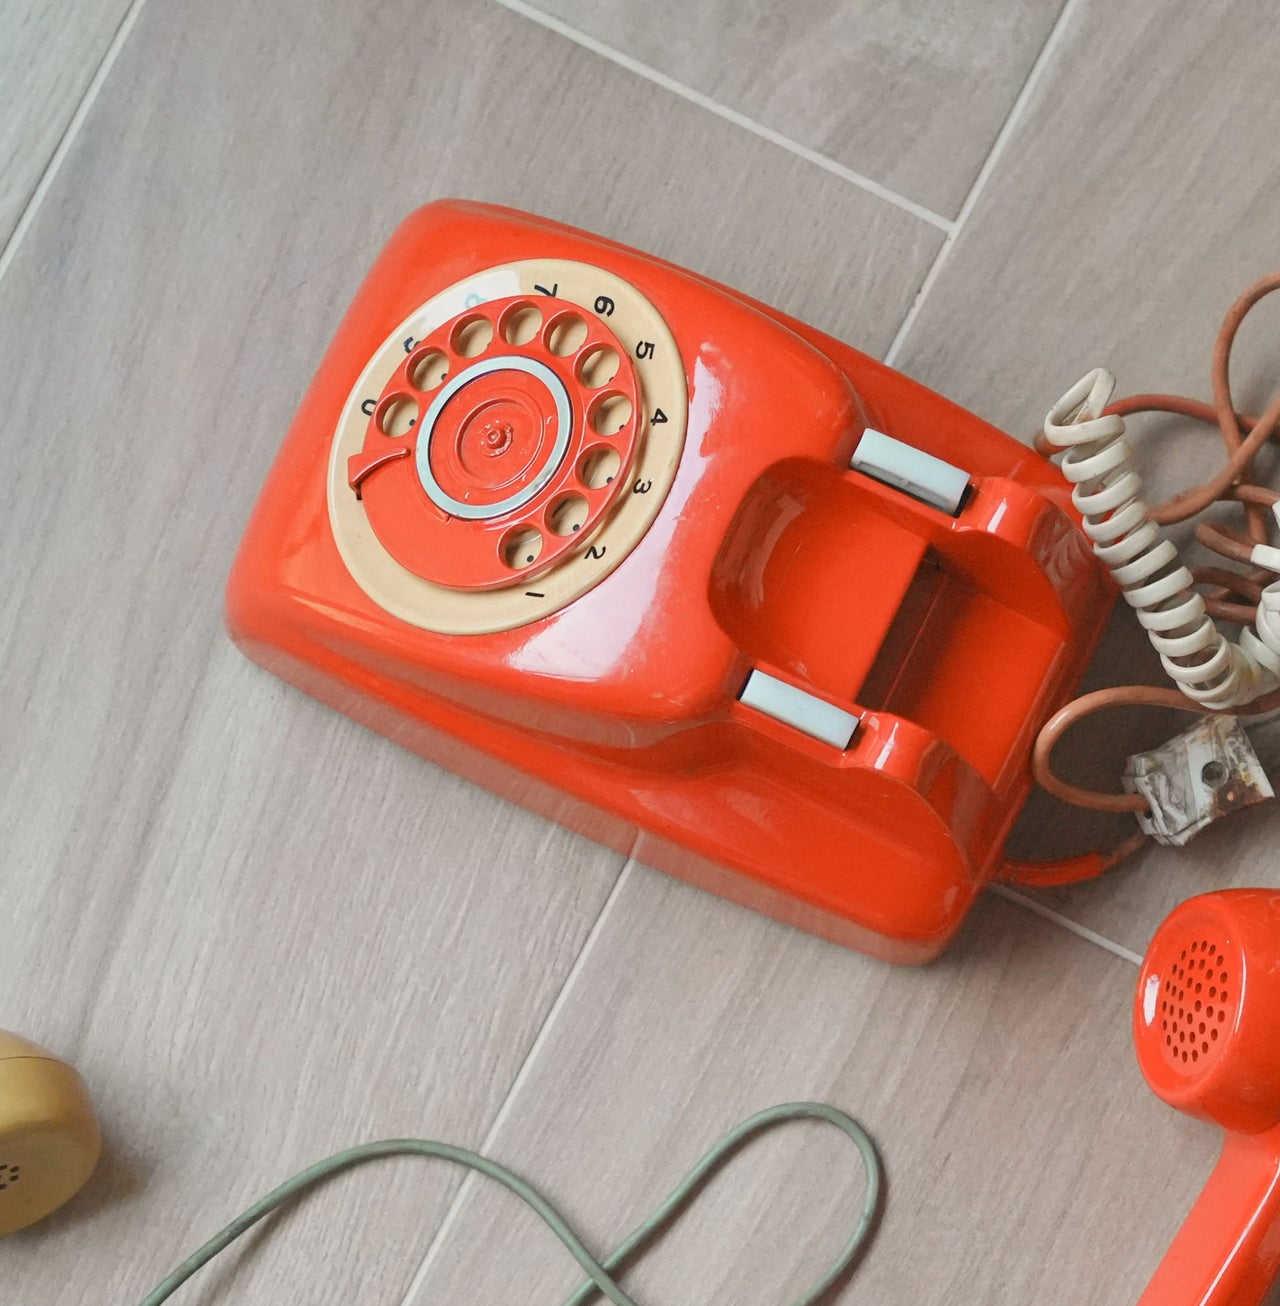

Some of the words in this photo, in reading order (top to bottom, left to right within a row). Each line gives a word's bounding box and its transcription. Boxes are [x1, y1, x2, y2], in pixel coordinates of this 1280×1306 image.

[534, 283, 558, 298] 7
[593, 295, 615, 317] 6
[634, 340, 656, 360] 5
[649, 407, 669, 427] 4
[632, 478, 652, 495] 3
[583, 545, 607, 560] 2
